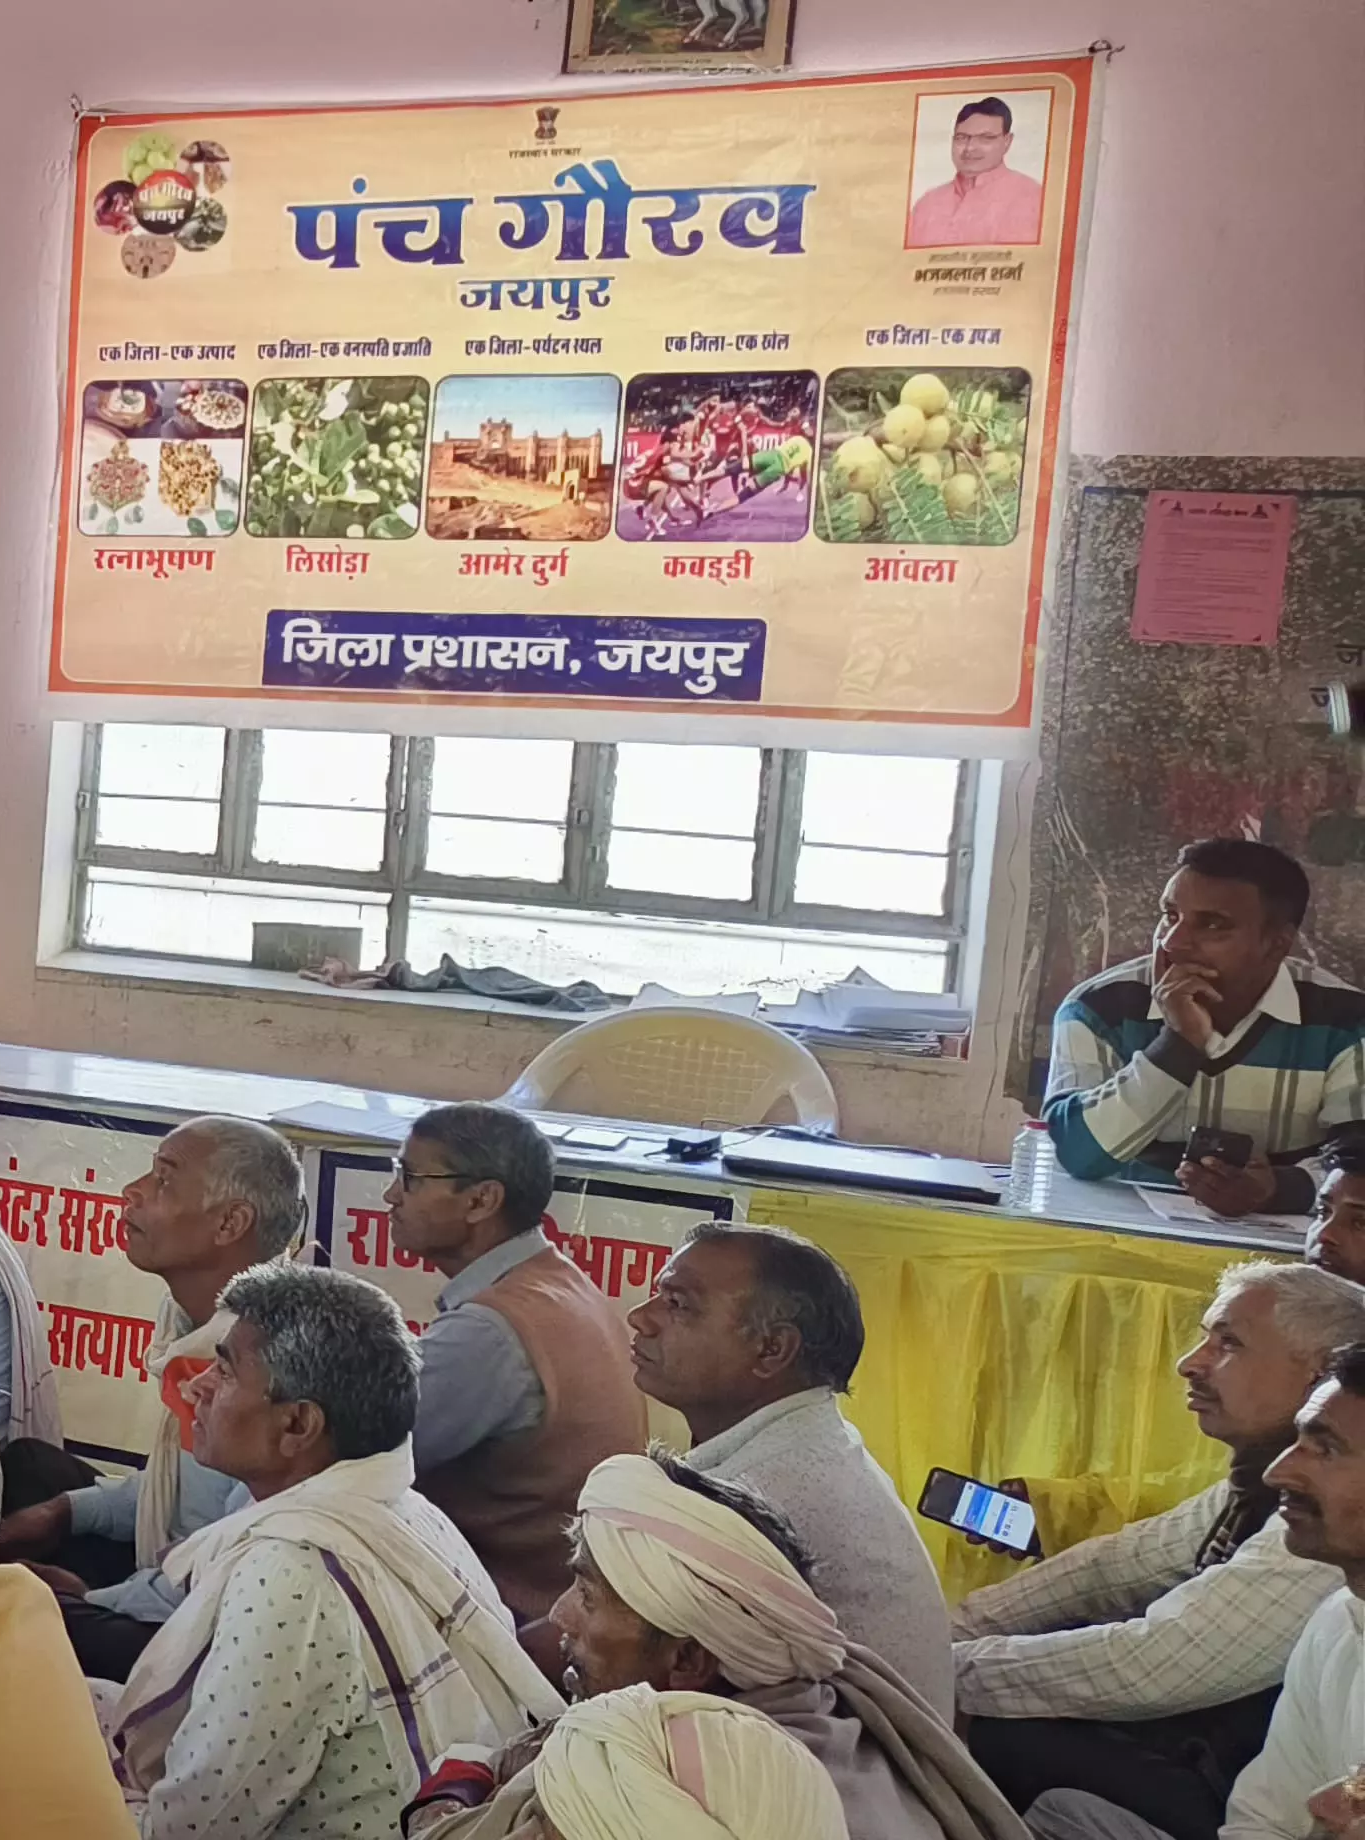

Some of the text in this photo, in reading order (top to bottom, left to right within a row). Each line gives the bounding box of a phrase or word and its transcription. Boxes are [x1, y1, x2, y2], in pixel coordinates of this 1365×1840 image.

[286, 158, 818, 269] पंच गौरव
[990, 262, 1025, 282] शर्मा
[459, 275, 616, 321] जयपुर
[464, 338, 486, 356] एक
[665, 335, 687, 353] एक
[762, 330, 790, 351] खेल
[866, 328, 890, 347] एक
[968, 327, 1002, 346] उपज
[98, 346, 120, 362] एक
[257, 344, 277, 360] एक
[92, 546, 215, 580] रत्नाभूषण
[285, 544, 370, 581] लिसोड़ा
[457, 546, 524, 577] आमेर
[531, 547, 570, 586] दुर्ग
[864, 549, 960, 583] आंवला
[281, 618, 395, 667] जिला
[594, 637, 751, 695] जयपुर
[47, 1303, 157, 1383] सत्याप
